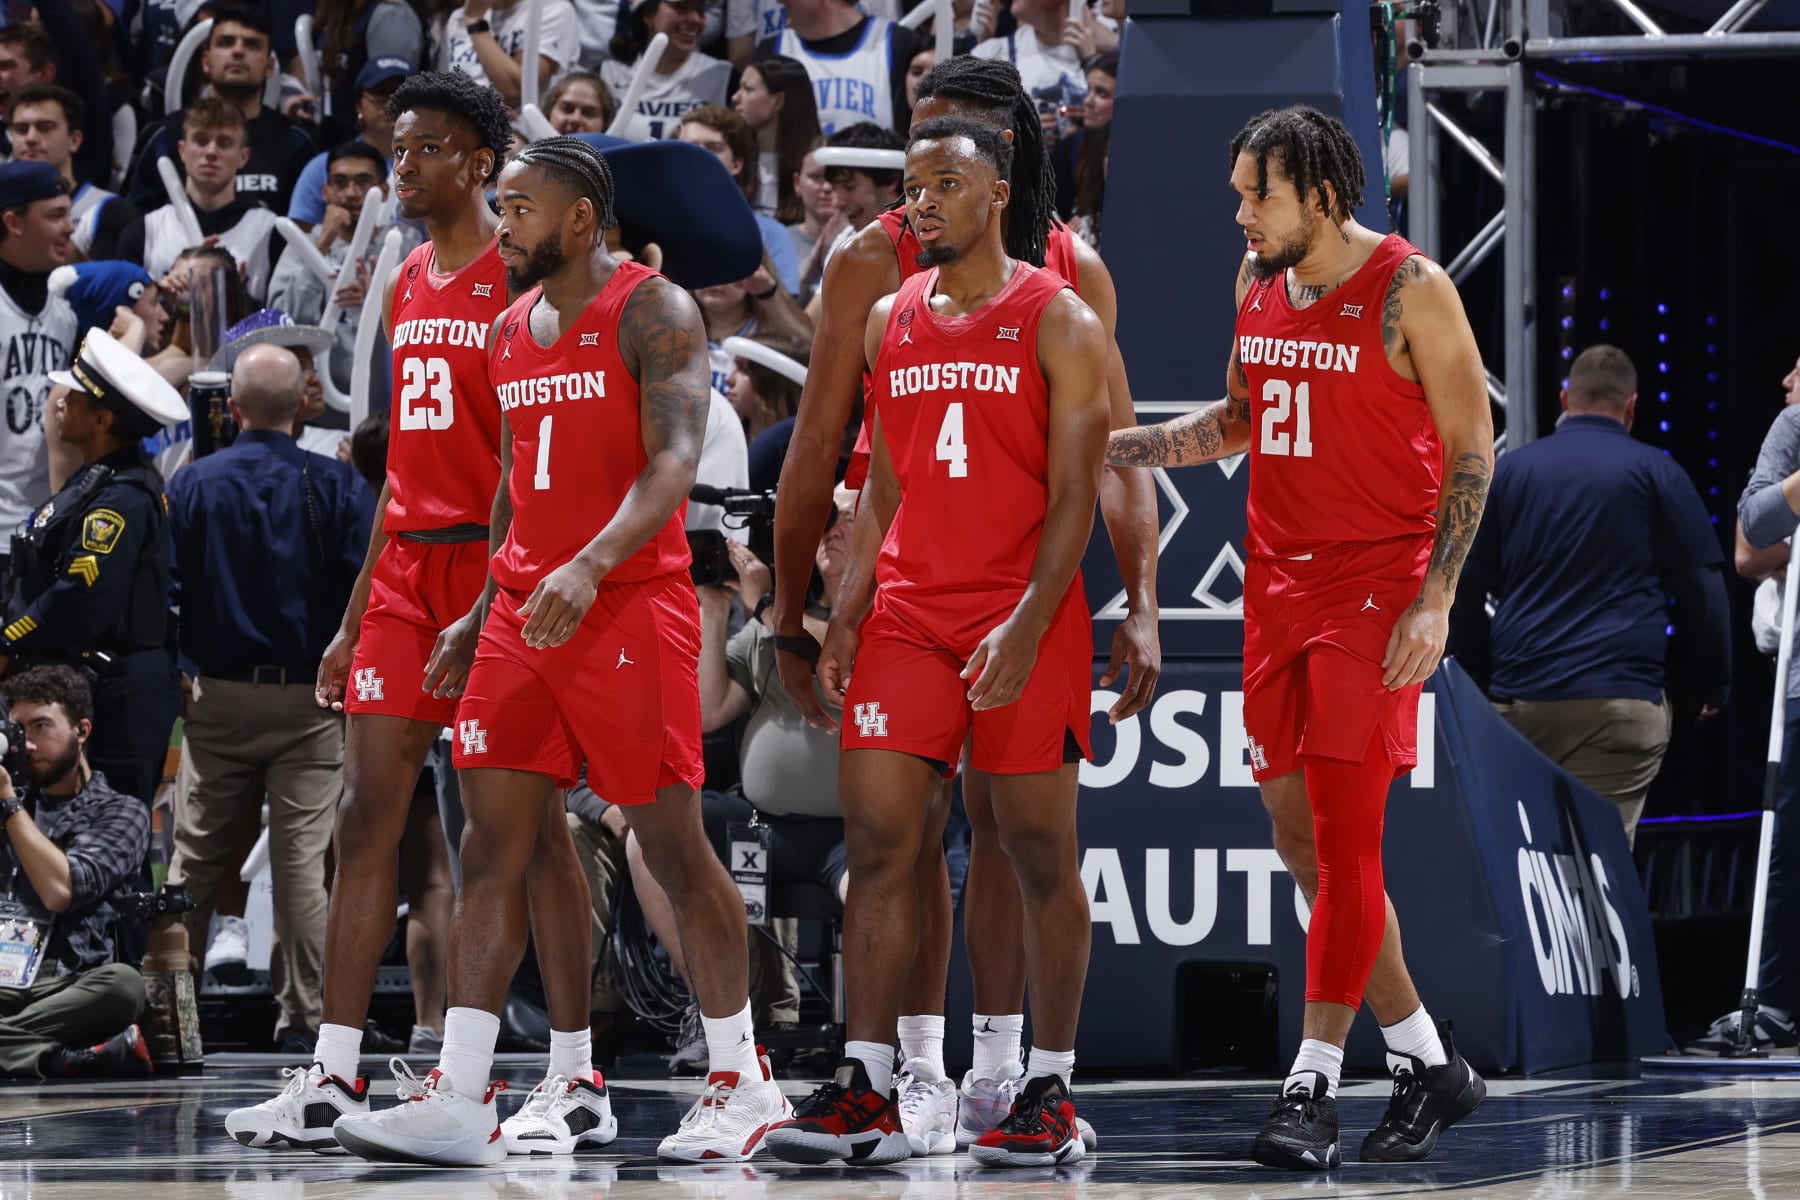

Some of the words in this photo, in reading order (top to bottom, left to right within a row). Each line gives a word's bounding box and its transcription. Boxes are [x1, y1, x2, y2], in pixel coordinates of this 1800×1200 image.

[615, 99, 706, 117] AVIE
[811, 77, 876, 119] VIER
[236, 174, 278, 191] IER
[392, 318, 489, 351] HOUSTON
[1239, 336, 1360, 373] HOUSTON
[0, 333, 67, 380] AVIE
[400, 357, 454, 431] 23
[496, 371, 605, 412] HOUSTON
[889, 362, 1020, 398] HOUSTON
[1260, 379, 1313, 458] 21
[534, 415, 553, 490] 1
[936, 402, 968, 478] 4
[742, 851, 758, 869] X
[1079, 848, 1312, 946] AUT
